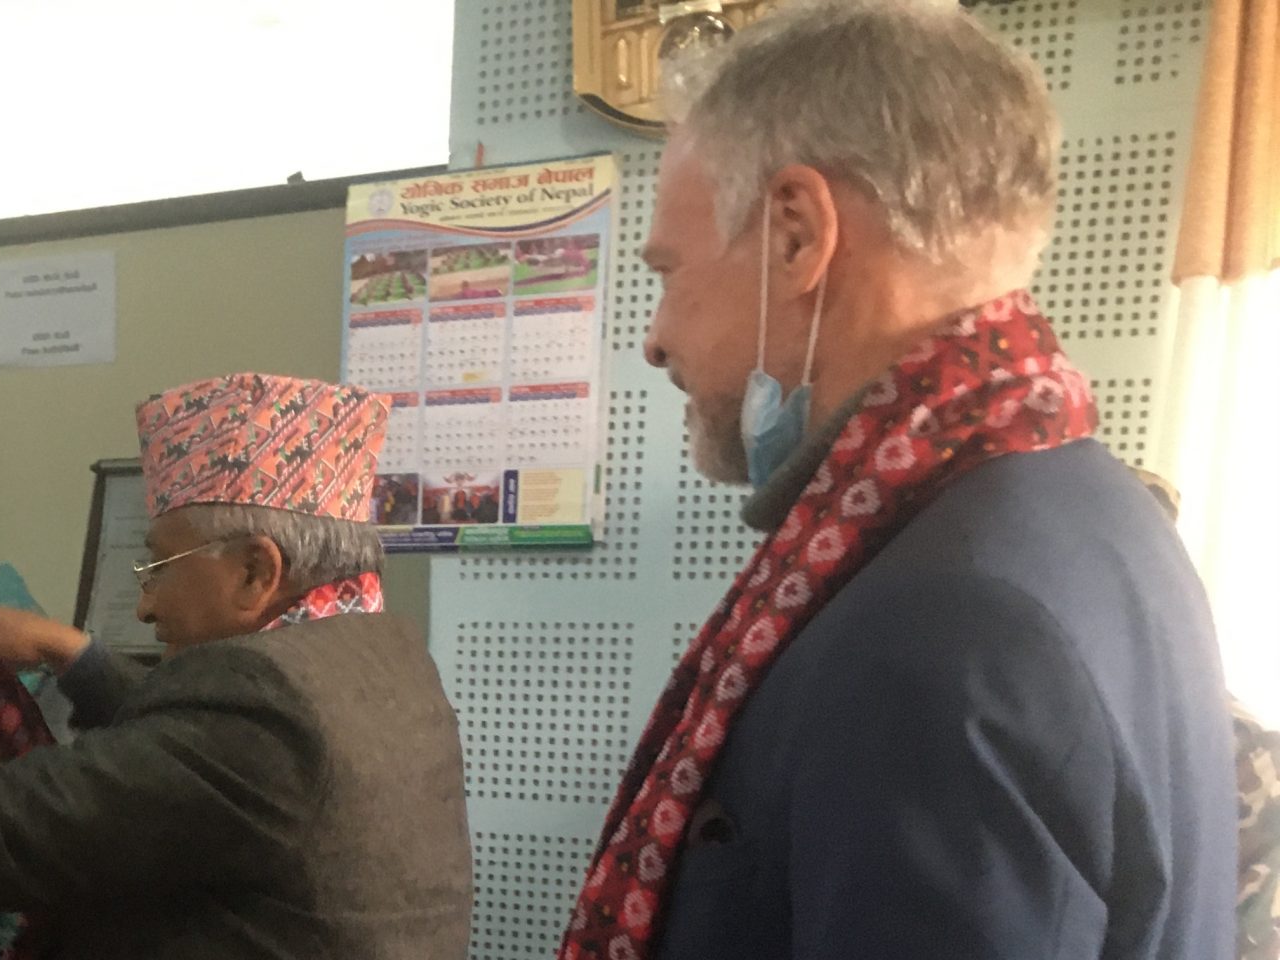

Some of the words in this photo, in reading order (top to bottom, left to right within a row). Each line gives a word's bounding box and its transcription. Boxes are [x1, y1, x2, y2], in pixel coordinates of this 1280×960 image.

[400, 200, 444, 217] Yogic
[449, 193, 512, 210] Society
[516, 186, 536, 202] of
[541, 183, 595, 204] Nepal
